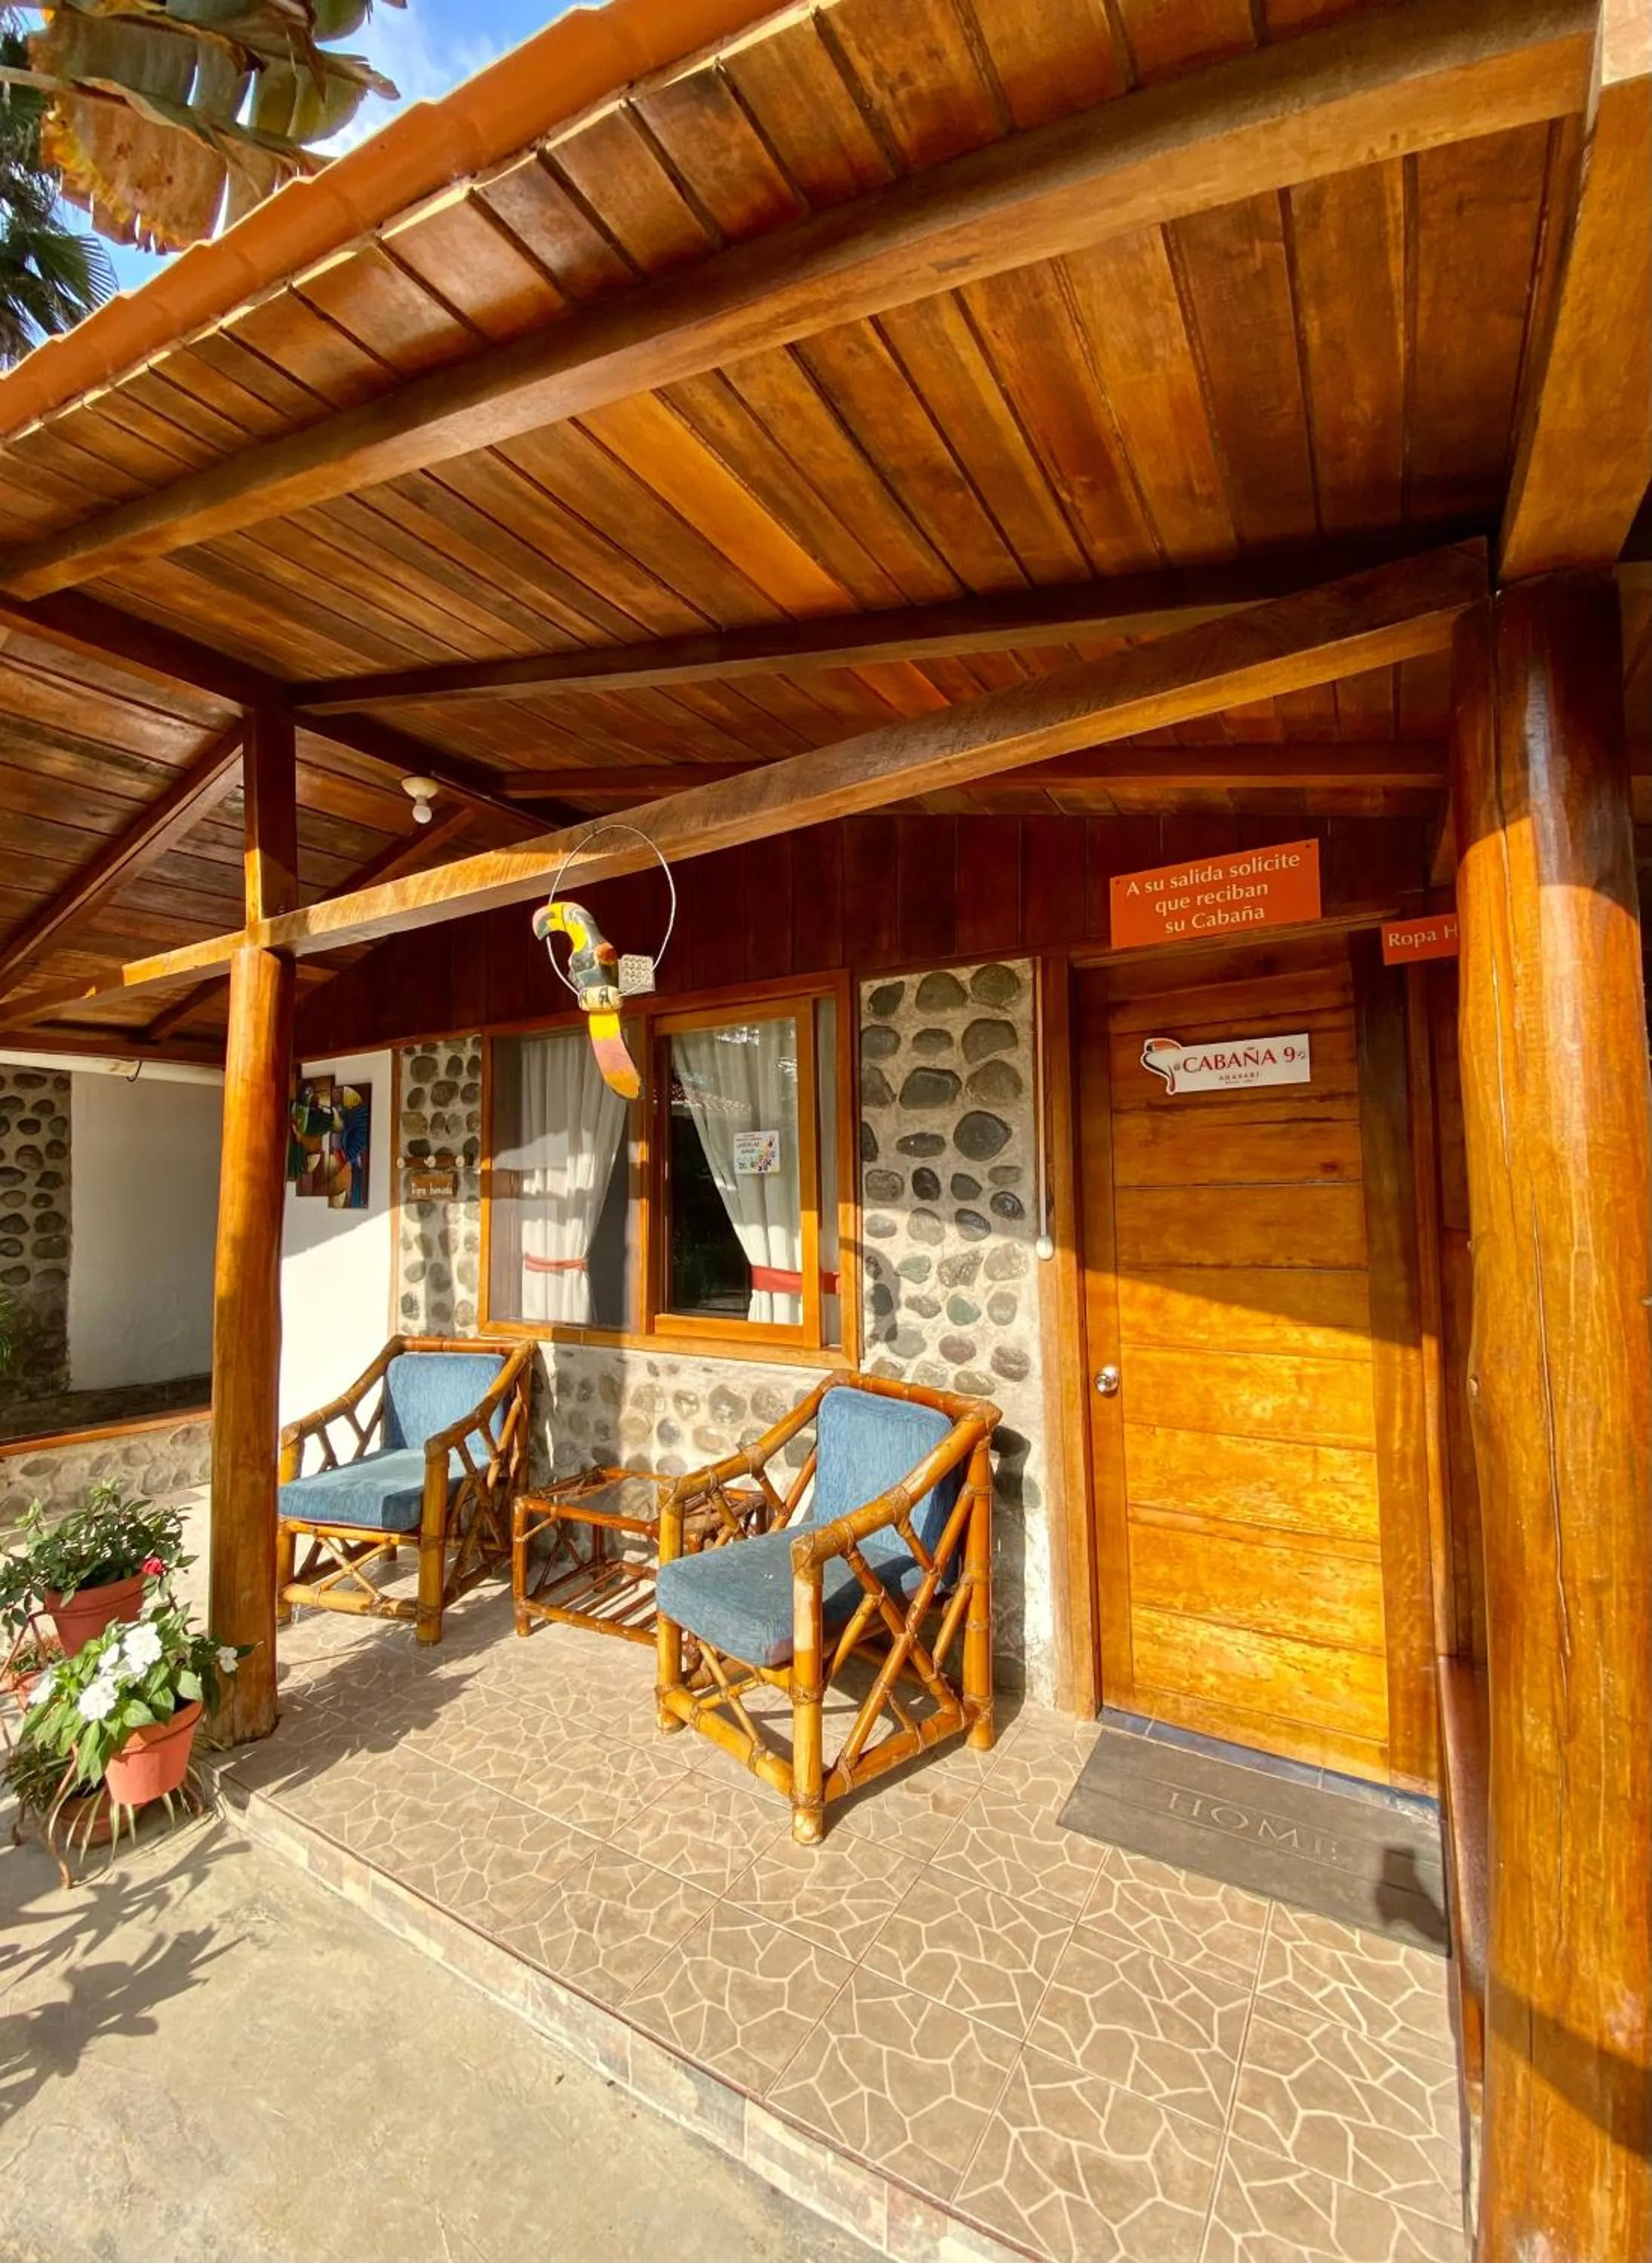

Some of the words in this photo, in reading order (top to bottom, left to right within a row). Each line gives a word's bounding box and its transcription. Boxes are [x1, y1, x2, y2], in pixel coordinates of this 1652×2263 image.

[1126, 881, 1140, 897] A
[1144, 878, 1164, 894] su
[1170, 865, 1223, 889] salida
[1230, 853, 1300, 878] solicite
[1155, 895, 1190, 917] que
[1196, 883, 1269, 906] reciban
[1165, 919, 1185, 934] su
[1191, 905, 1265, 929] Cabaña
[1389, 930, 1437, 948] Ropa
[1182, 1046, 1277, 1073] CABAÑA
[1283, 1046, 1296, 1063] 9
[1168, 1792, 1338, 1861] HOME
